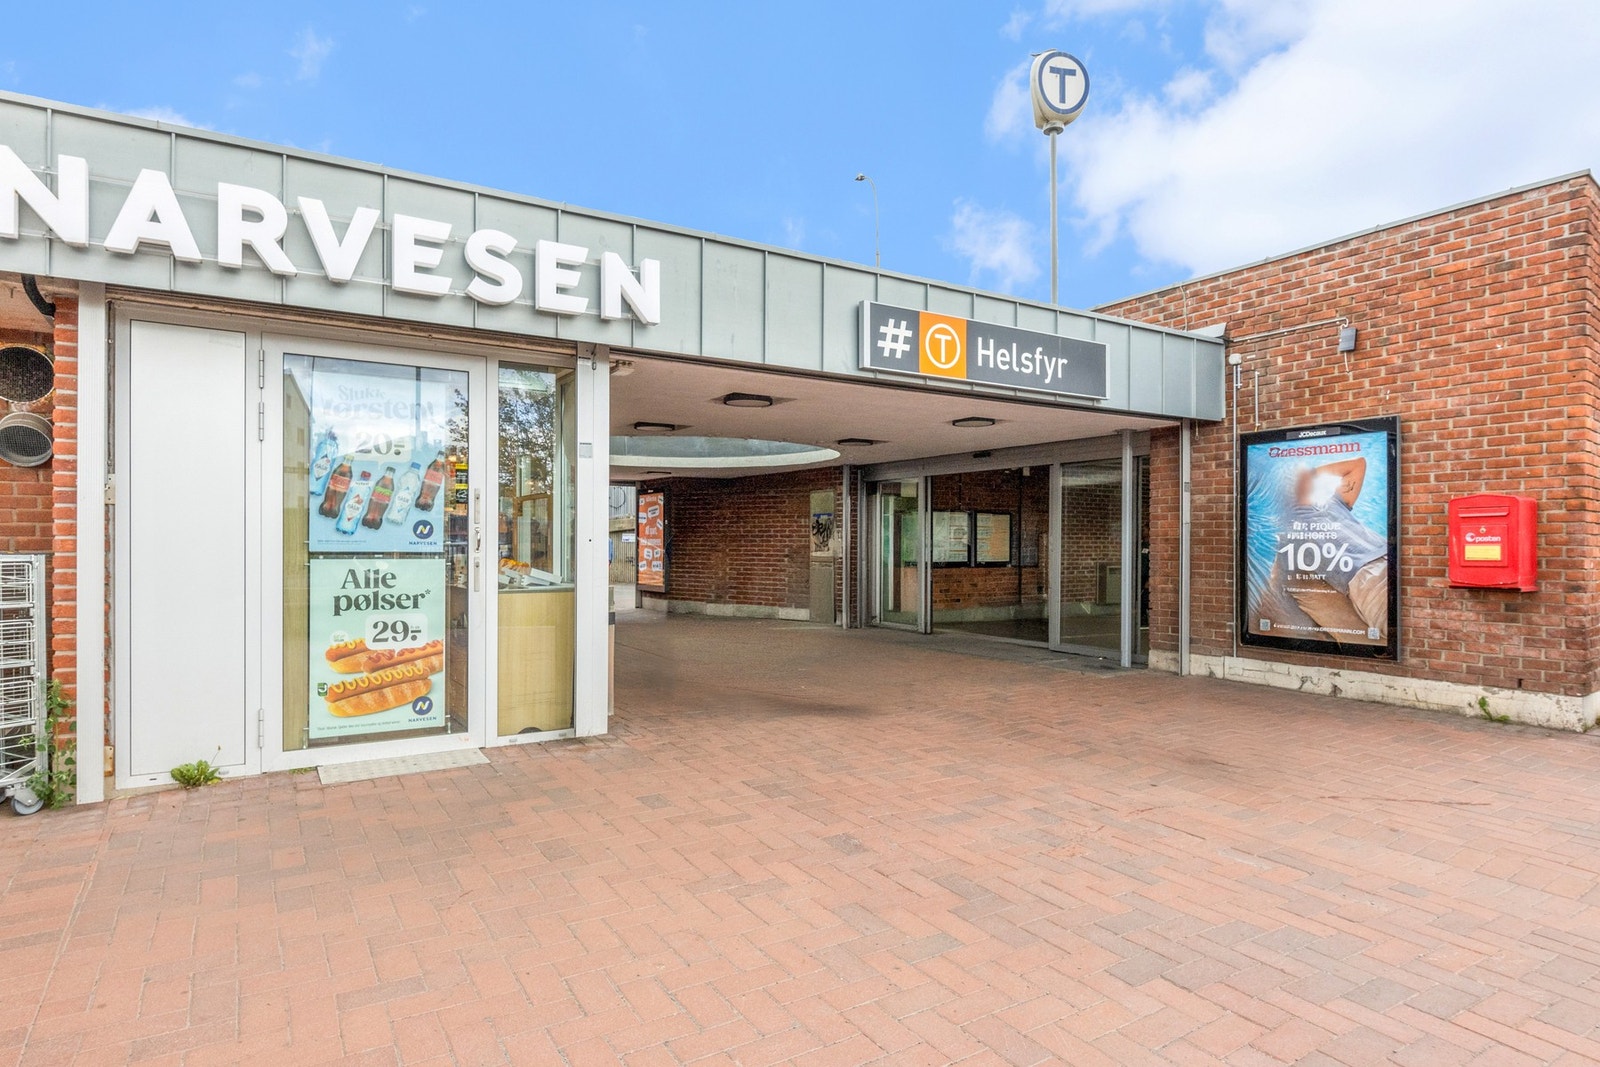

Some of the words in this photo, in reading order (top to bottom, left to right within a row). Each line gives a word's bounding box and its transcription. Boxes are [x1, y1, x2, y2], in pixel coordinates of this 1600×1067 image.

[1049, 66, 1077, 104] T
[0, 145, 661, 326] NARVESEN
[977, 336, 1068, 384] Helsfyr
[1268, 442, 1361, 458] Dressmann
[1300, 531, 1338, 540] HORTS
[1278, 542, 1354, 573] 10%
[340, 568, 397, 590] Alle
